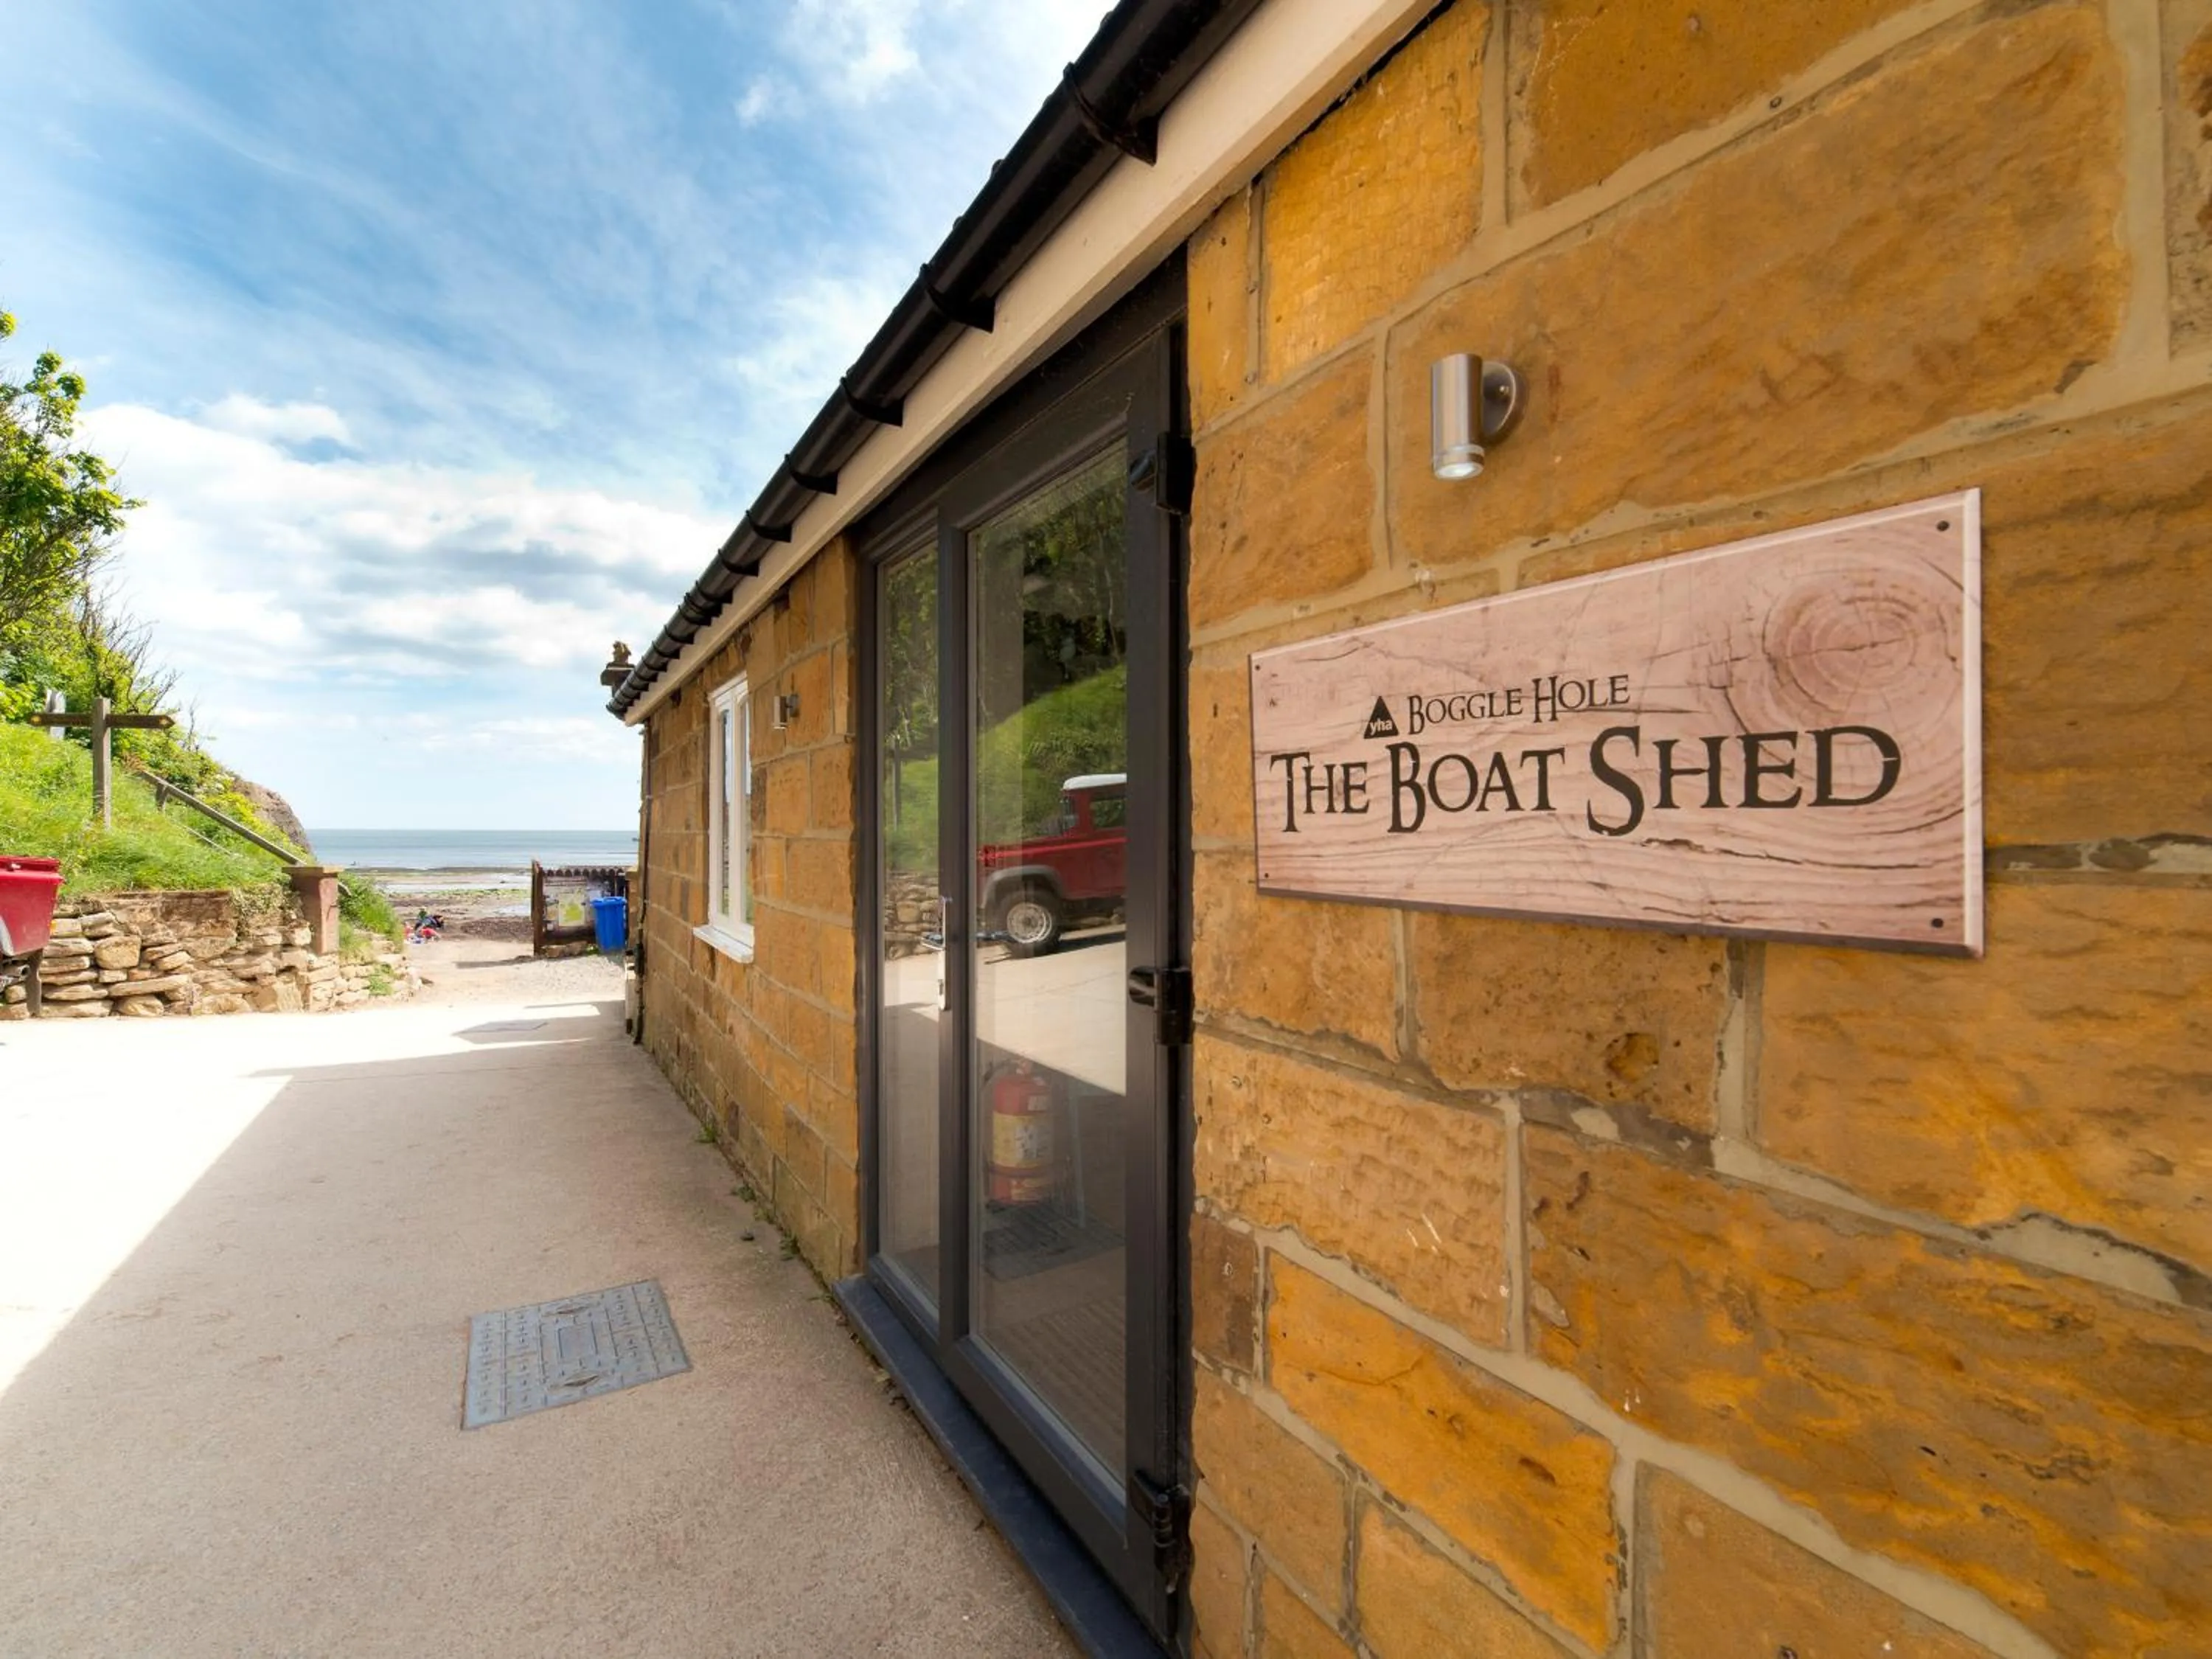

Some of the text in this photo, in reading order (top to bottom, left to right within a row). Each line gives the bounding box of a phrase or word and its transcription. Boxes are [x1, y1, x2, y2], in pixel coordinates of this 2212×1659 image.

[1370, 718, 1393, 734] yha
[1408, 675, 1630, 734] BOGGLE HOLE
[1270, 726, 1902, 836] THE BOAT SHED
